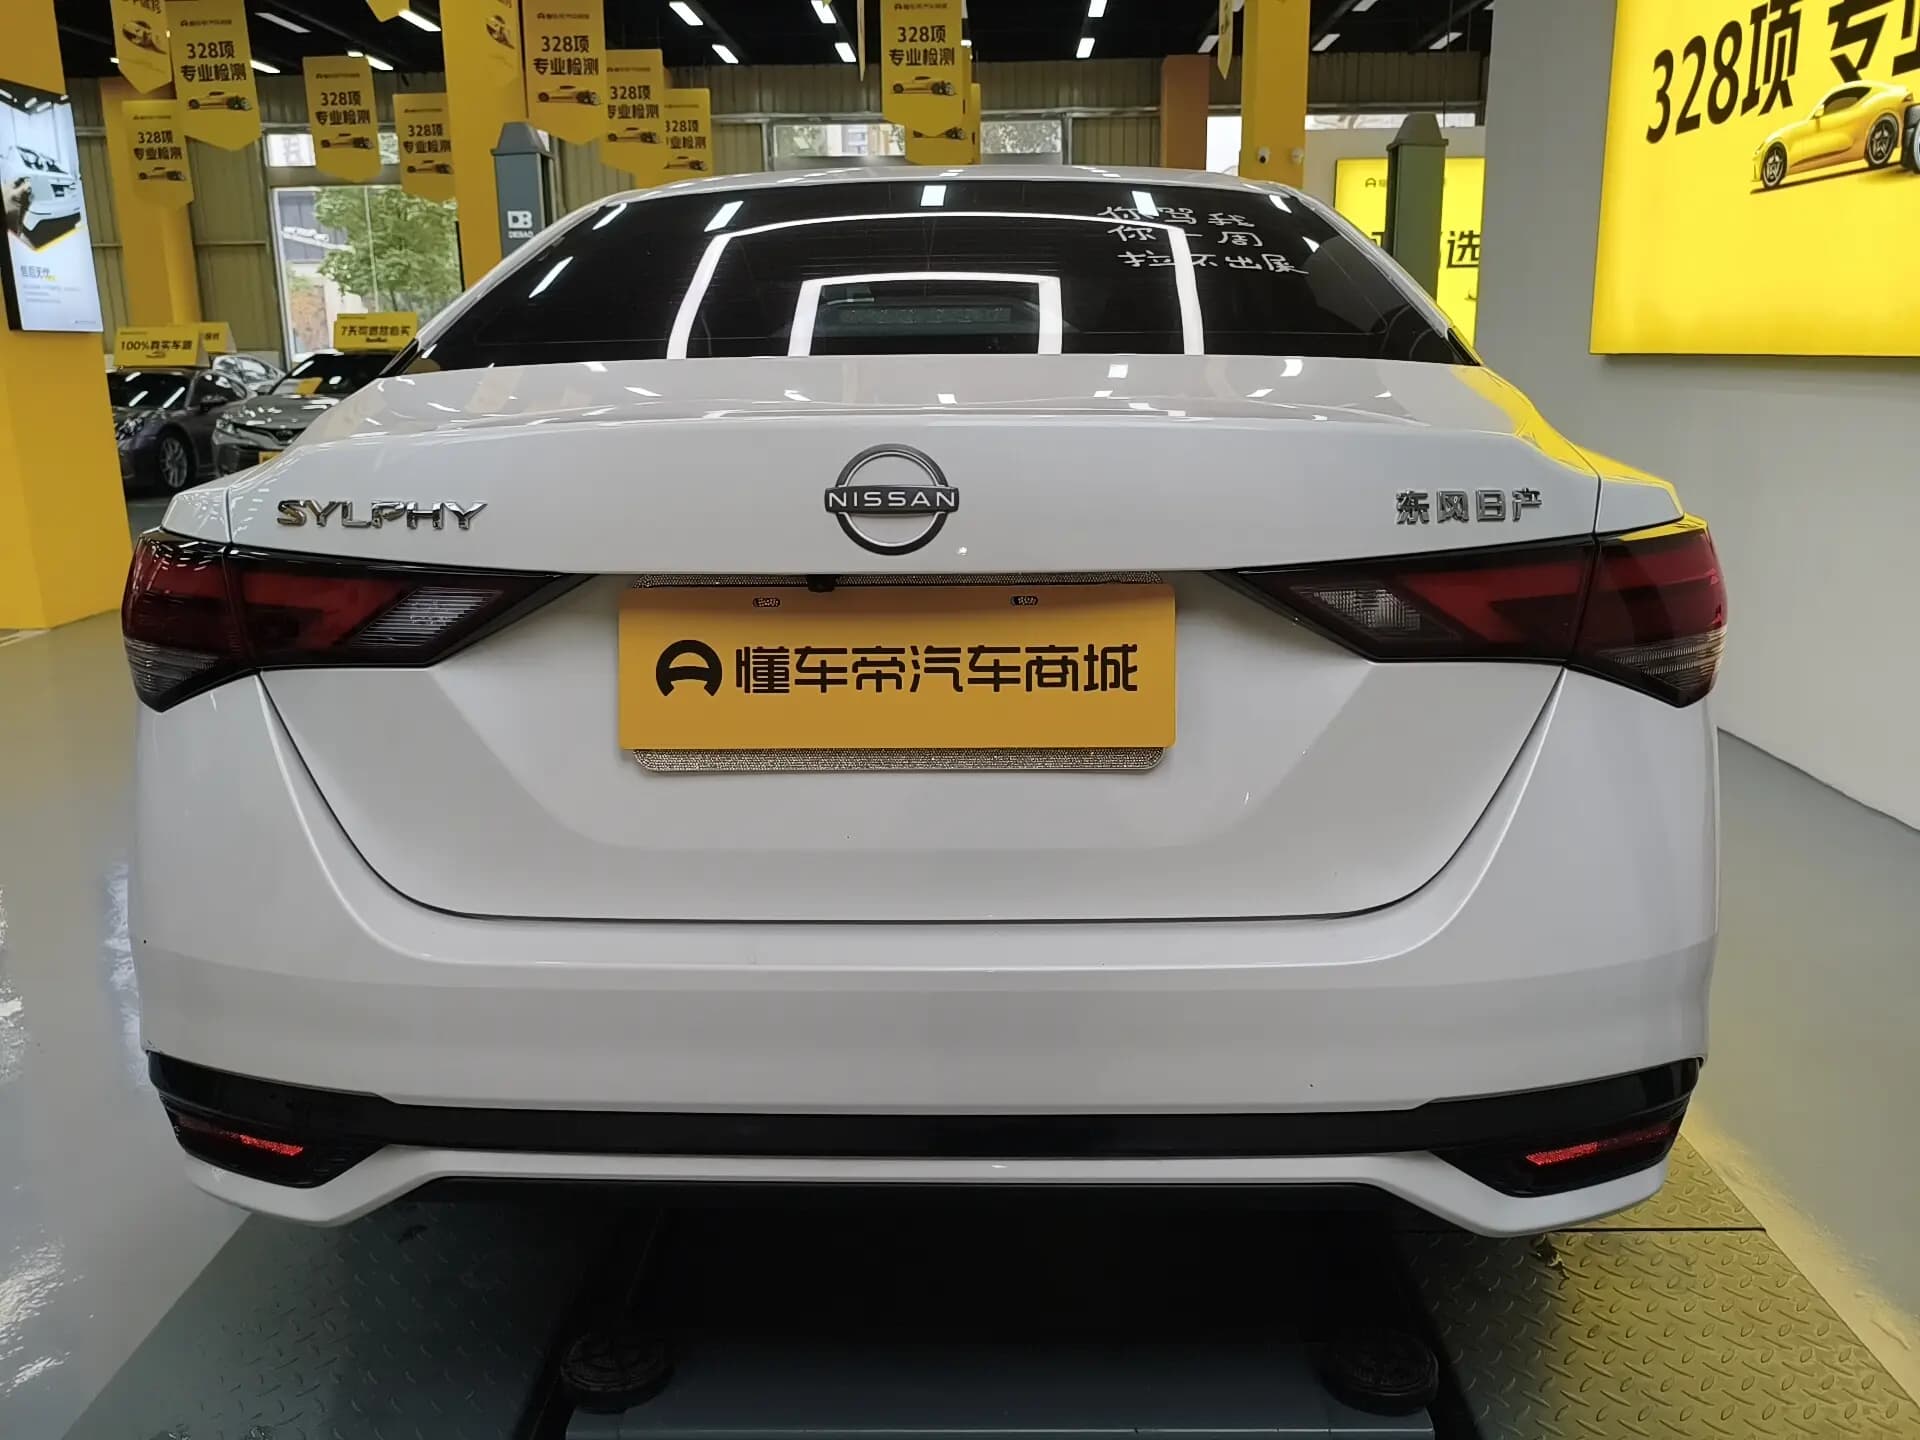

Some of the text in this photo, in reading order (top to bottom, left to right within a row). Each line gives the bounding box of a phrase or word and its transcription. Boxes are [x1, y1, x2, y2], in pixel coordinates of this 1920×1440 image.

[898, 25, 946, 43] 328项
[186, 41, 235, 59] 328项
[541, 35, 589, 53] 328项
[889, 47, 955, 66] 专业检测
[181, 63, 246, 82] 专业检测
[533, 57, 599, 75] 专业检测
[1646, 0, 1920, 144] 328项 专
[321, 91, 361, 106] 328项
[610, 85, 651, 100] 328项
[138, 130, 173, 144] 328项
[408, 123, 443, 137] 328项
[829, 491, 955, 508] NISSAN
[1396, 488, 1542, 524] 东风日产
[277, 500, 488, 530] SYLPHY
[736, 643, 1139, 694] 懂车帝汽车商城
